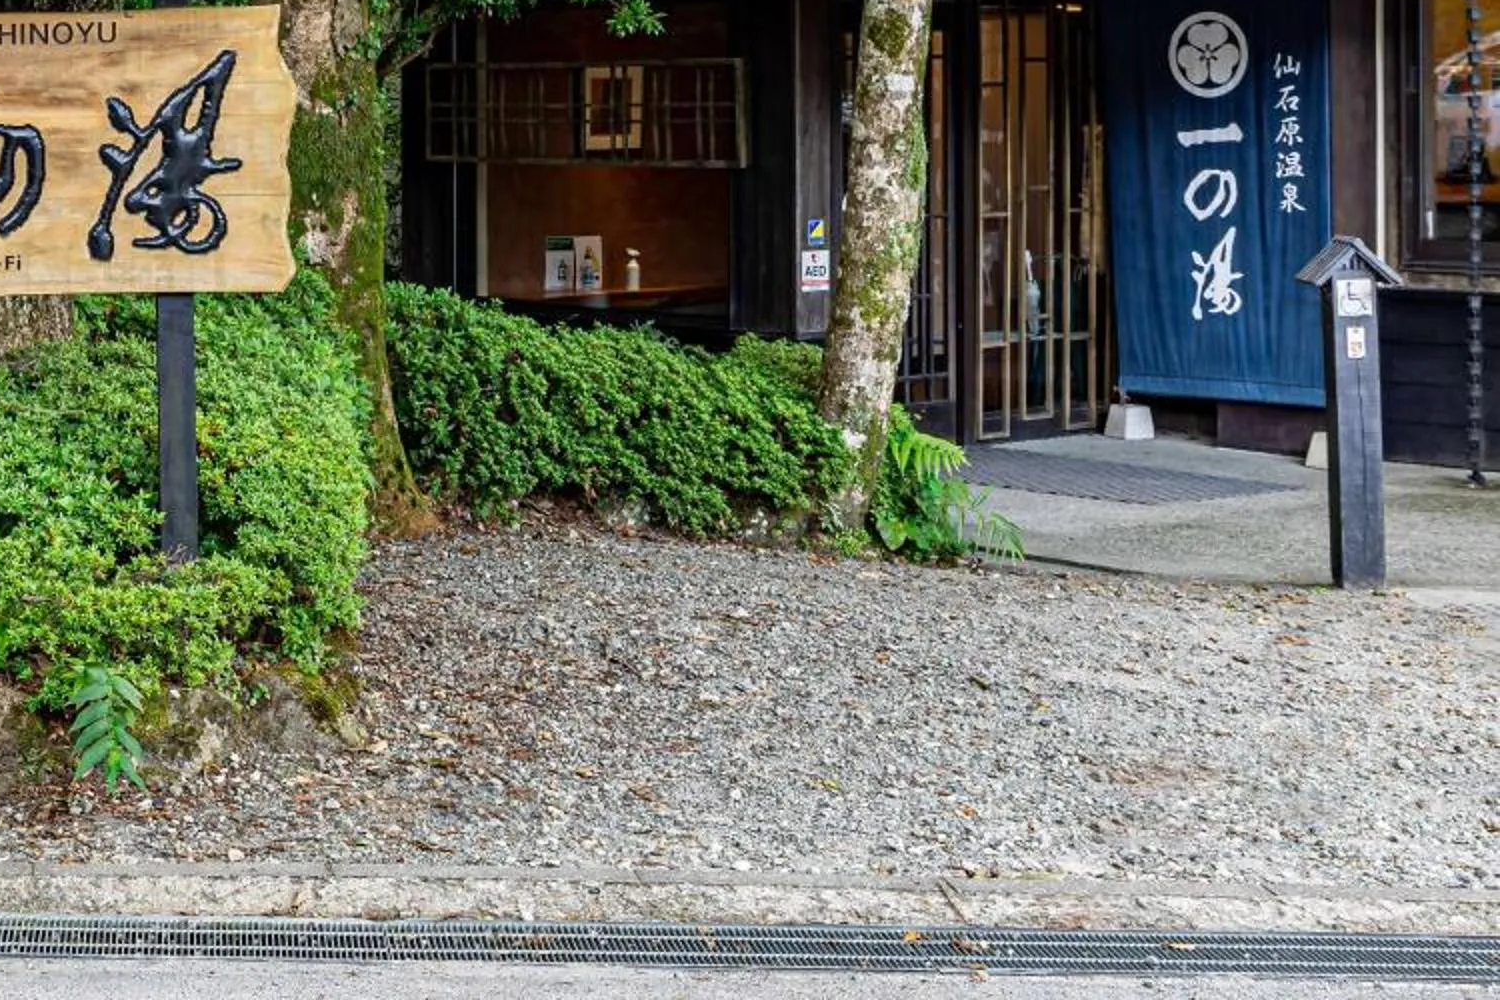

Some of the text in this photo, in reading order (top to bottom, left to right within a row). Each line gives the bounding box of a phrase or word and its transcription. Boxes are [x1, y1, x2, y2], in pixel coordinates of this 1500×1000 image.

[1273, 52, 1307, 214] 仙石原温泉
[805, 265, 827, 277] AED
[1177, 122, 1244, 320] 一の湯
